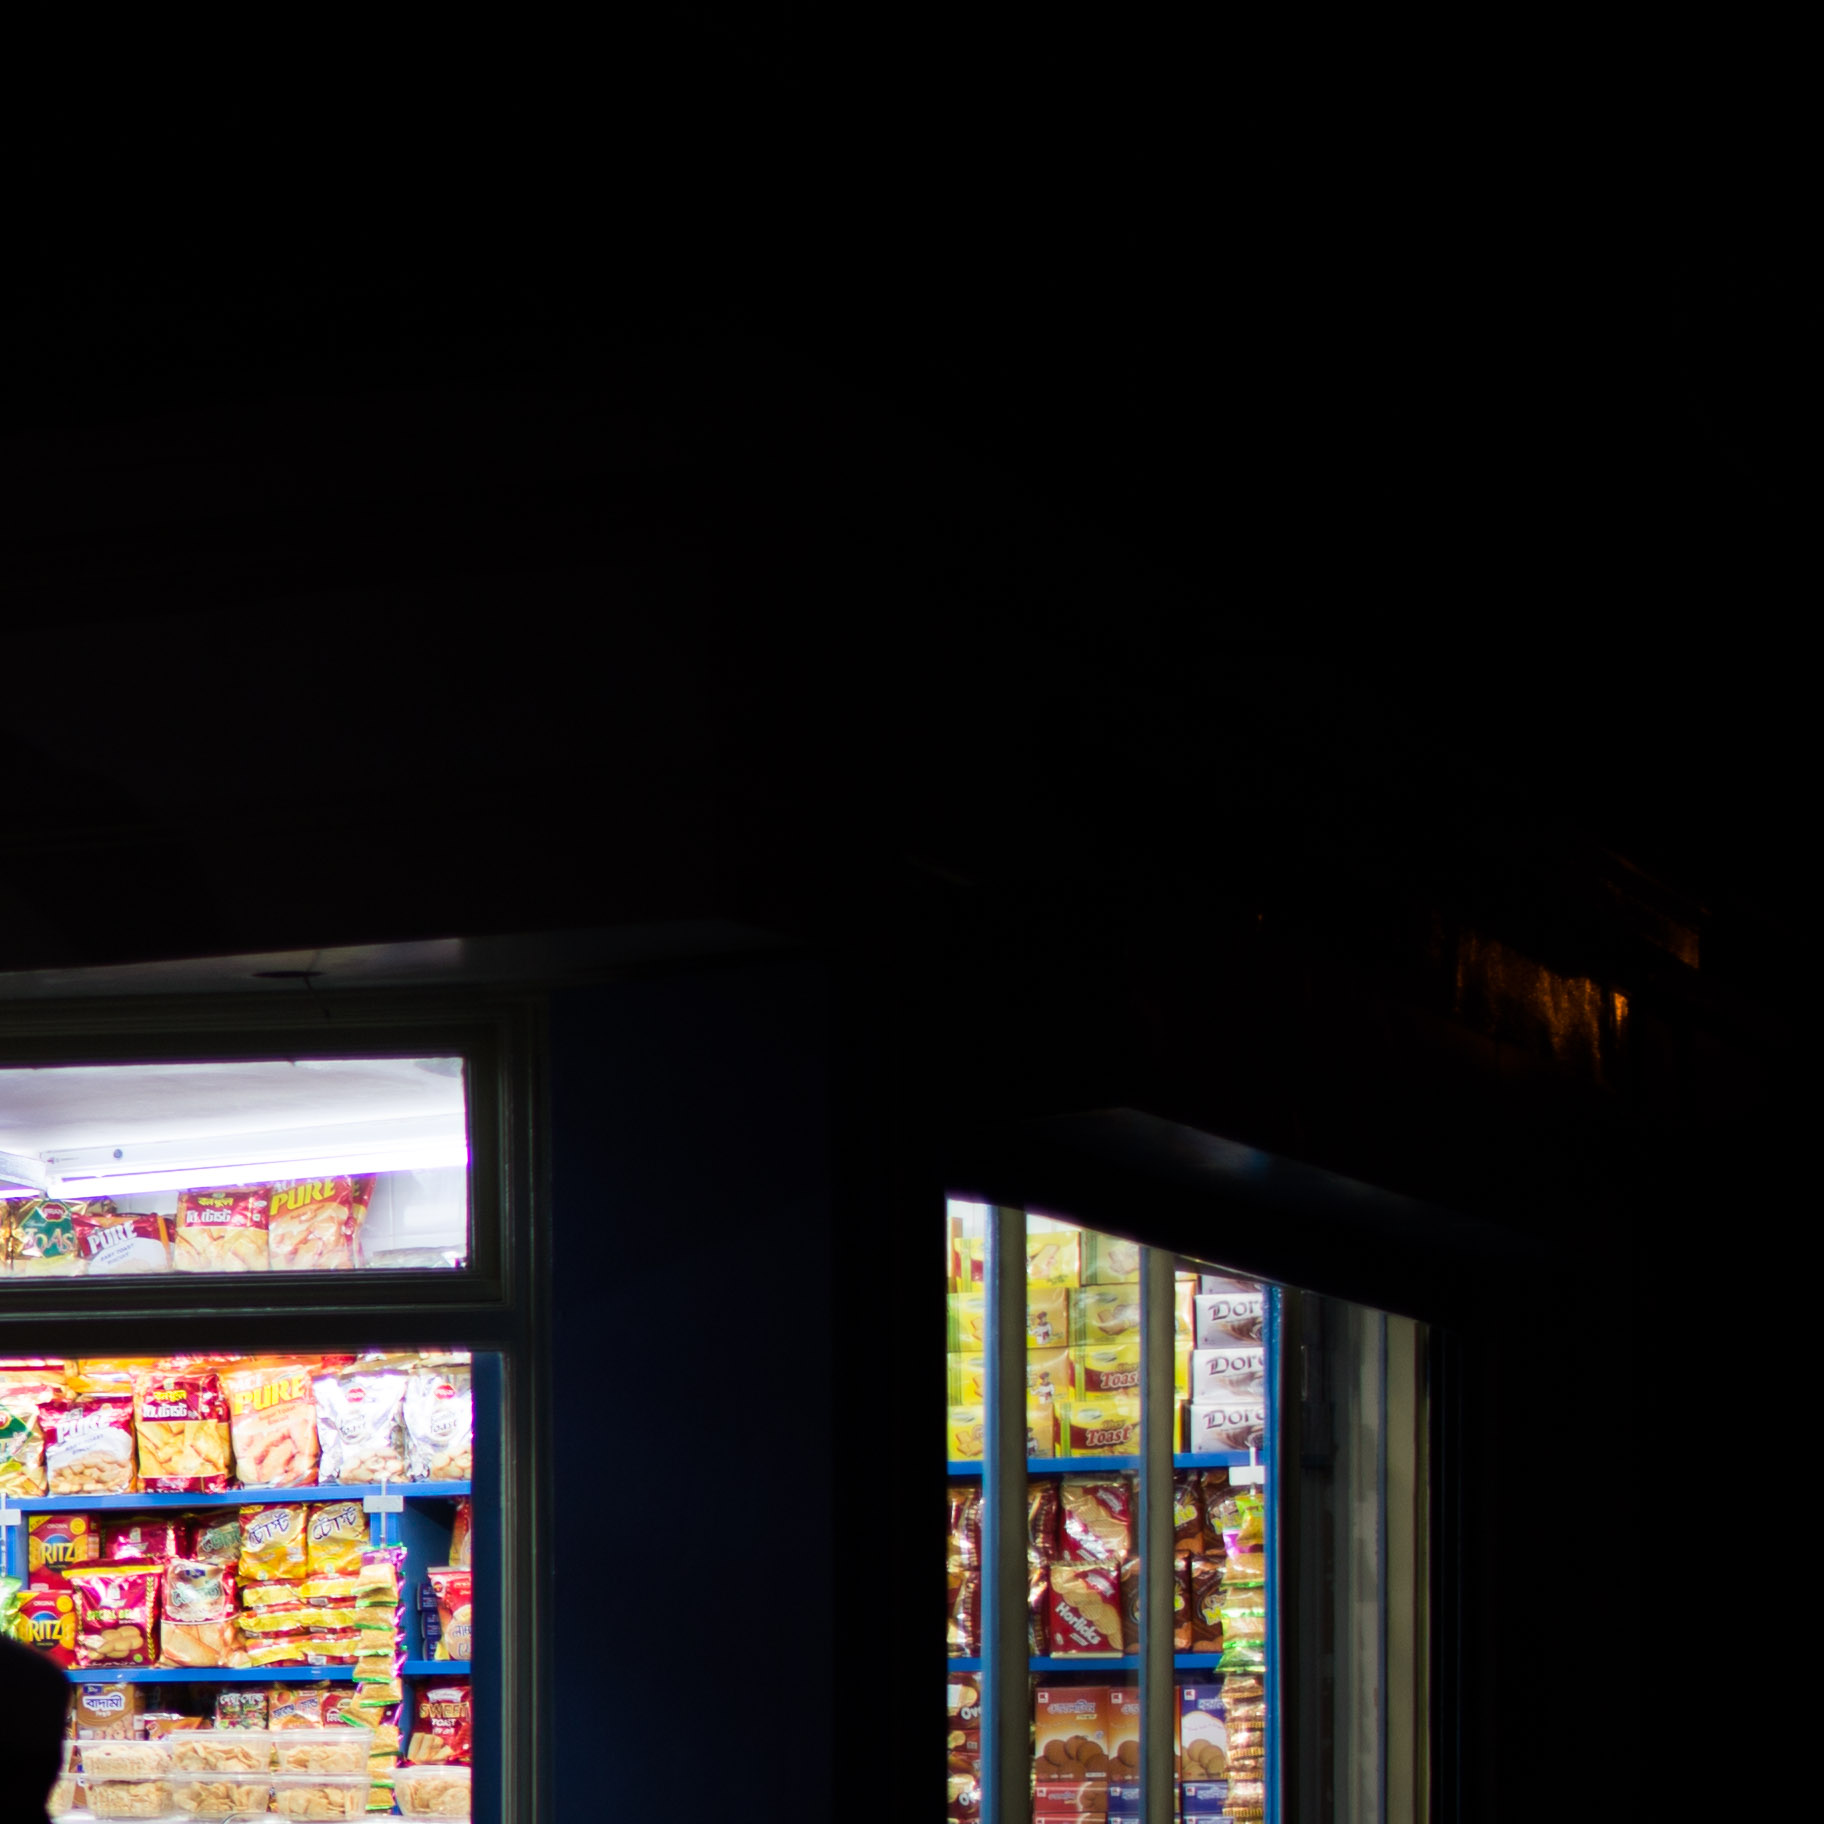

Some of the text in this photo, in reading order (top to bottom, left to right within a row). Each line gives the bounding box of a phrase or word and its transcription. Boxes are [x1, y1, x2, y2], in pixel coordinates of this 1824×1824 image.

[269, 1180, 336, 1216] PURE
[87, 1220, 138, 1255] PURE
[1100, 1371, 1140, 1389] Toas
[233, 1374, 305, 1415] PURE
[1086, 1424, 1133, 1447] Toast
[41, 1541, 76, 1565] RITZ
[27, 1620, 63, 1643] RITZ
[1055, 1601, 1102, 1646] Horlicks
[85, 1693, 123, 1710] বাদামী
[419, 1701, 469, 1718] SWEET
